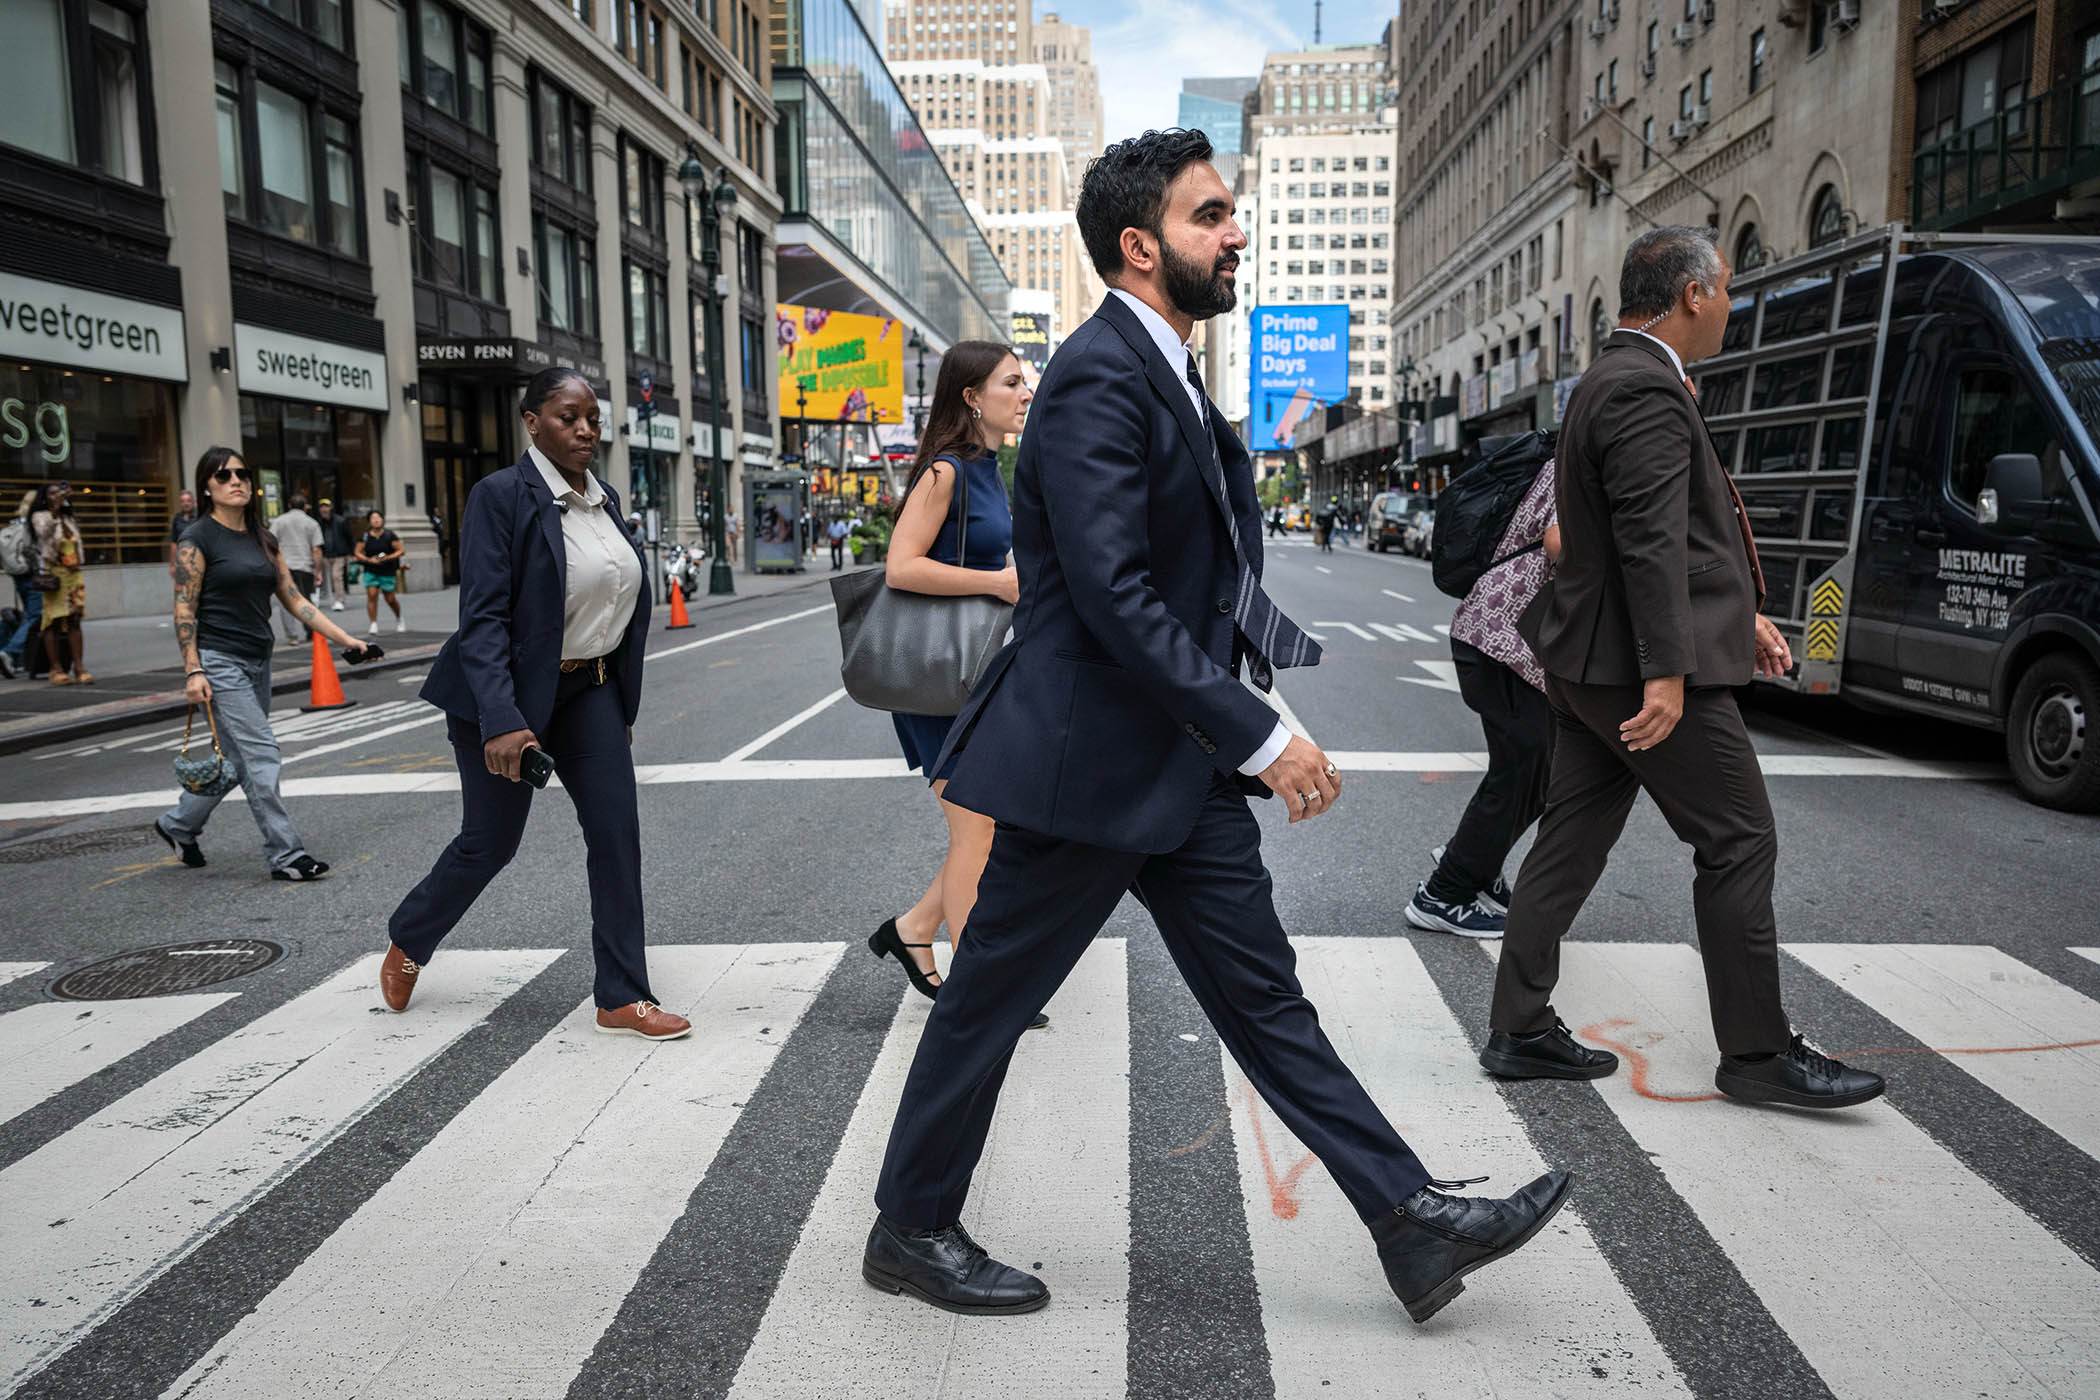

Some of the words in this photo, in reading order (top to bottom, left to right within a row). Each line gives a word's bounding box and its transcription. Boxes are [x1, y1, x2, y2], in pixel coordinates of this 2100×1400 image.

[1261, 313, 1319, 332] Prime
[419, 345, 466, 360] SEVEN
[474, 345, 514, 359] PENN
[1261, 333, 1292, 356] Big
[1294, 333, 1336, 352] Deal
[257, 348, 373, 391] sweetgreen
[1261, 354, 1307, 376] Days
[1, 397, 71, 463] sg
[1939, 548, 2026, 576] METRALITE
[1991, 590, 2008, 609] Ave
[1975, 608, 1988, 626] NY
